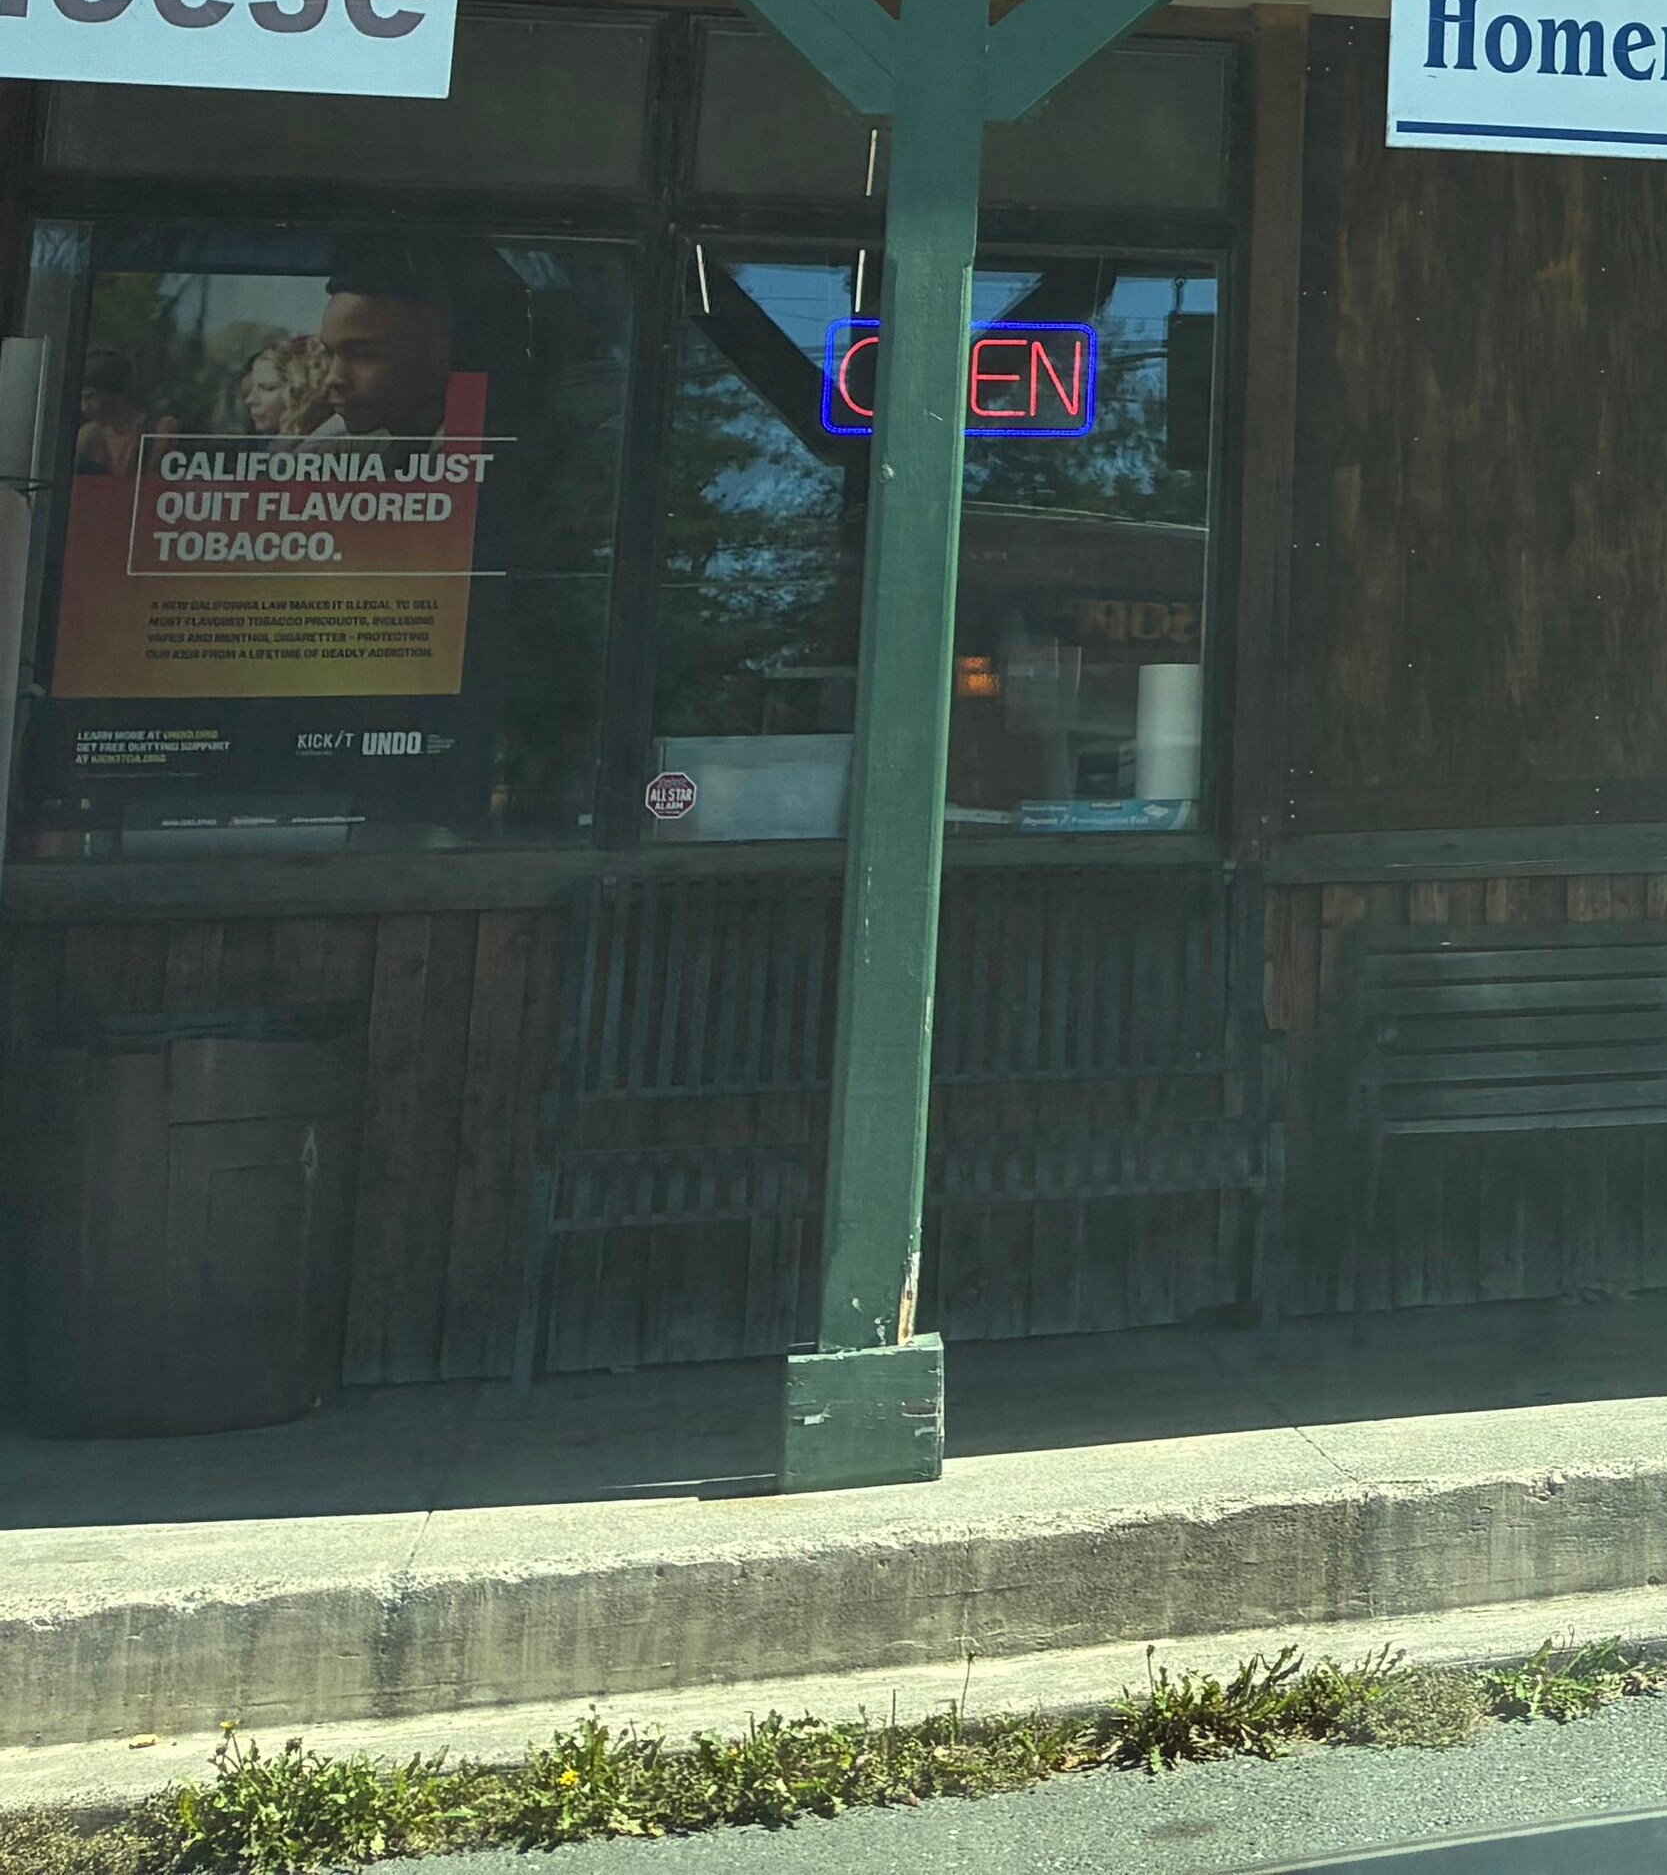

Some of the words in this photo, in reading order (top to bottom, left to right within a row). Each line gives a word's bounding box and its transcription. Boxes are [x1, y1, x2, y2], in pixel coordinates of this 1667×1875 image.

[839, 337, 1082, 417] OEN
[160, 451, 386, 483] CALIFORNIA
[394, 453, 495, 483] JUST
[156, 491, 249, 524] QUIT
[256, 492, 452, 522] FLAVORED
[153, 531, 343, 562] TOBACCO.
[261, 600, 287, 610] LAW
[361, 731, 422, 755] UNDO
[668, 788, 692, 802] STAR
